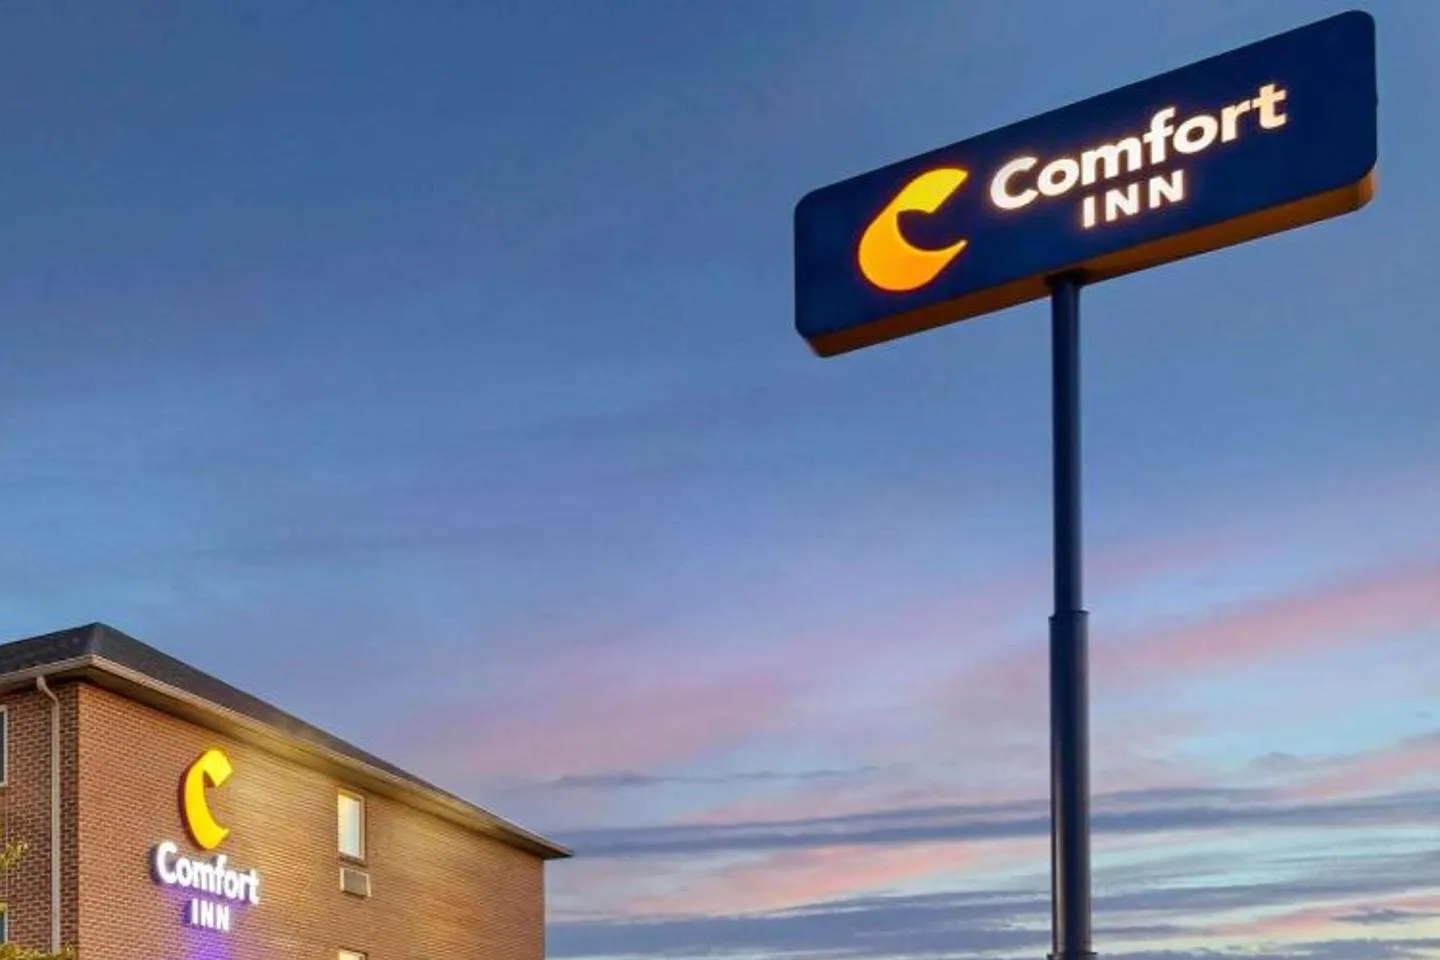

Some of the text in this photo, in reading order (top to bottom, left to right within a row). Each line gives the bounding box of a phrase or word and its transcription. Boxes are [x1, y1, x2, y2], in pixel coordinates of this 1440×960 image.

[989, 83, 1288, 211] Comfort
[1081, 169, 1184, 228] INN
[155, 841, 261, 904] Comfort
[189, 898, 230, 930] INN
